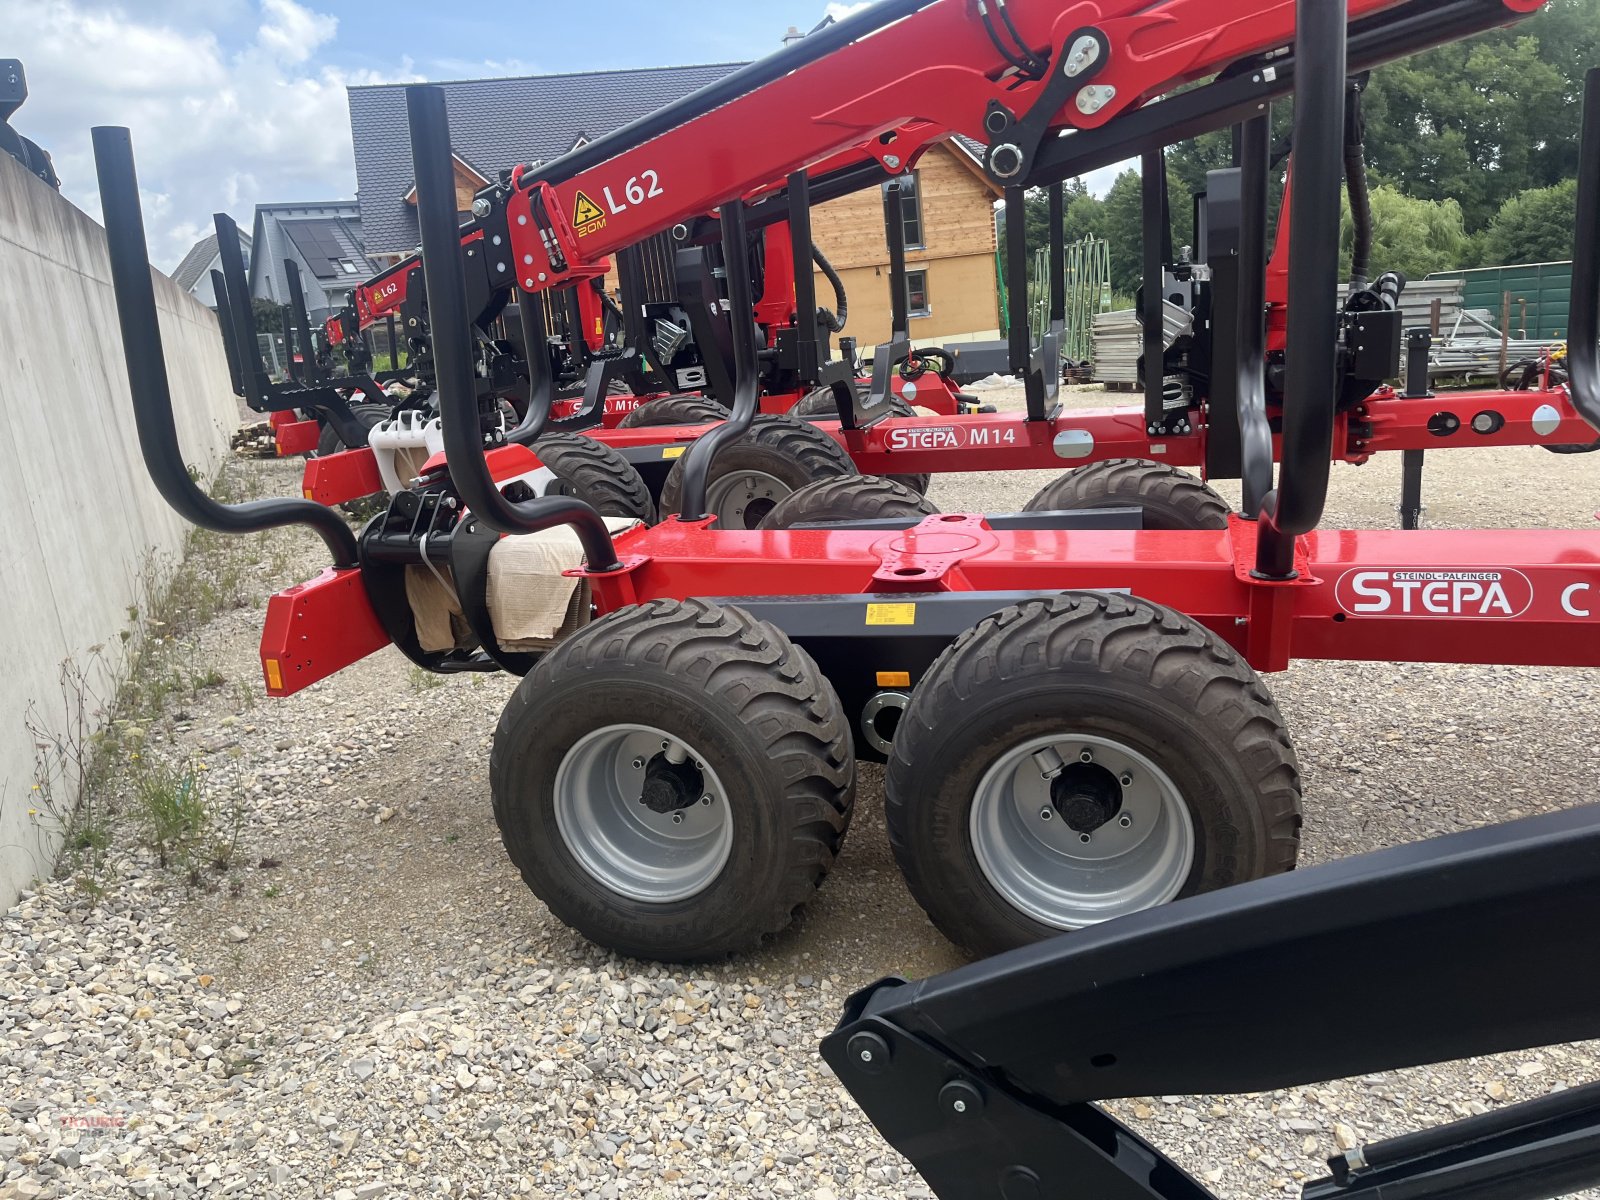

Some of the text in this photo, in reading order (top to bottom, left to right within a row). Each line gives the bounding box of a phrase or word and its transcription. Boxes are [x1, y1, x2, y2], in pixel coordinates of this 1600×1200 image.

[603, 169, 664, 215] L62
[577, 218, 607, 238] 20M
[381, 282, 398, 298] L62
[891, 428, 959, 449] STEPA
[1395, 572, 1500, 581] STEINDL-PALFINGER
[1352, 571, 1513, 614] STEPA
